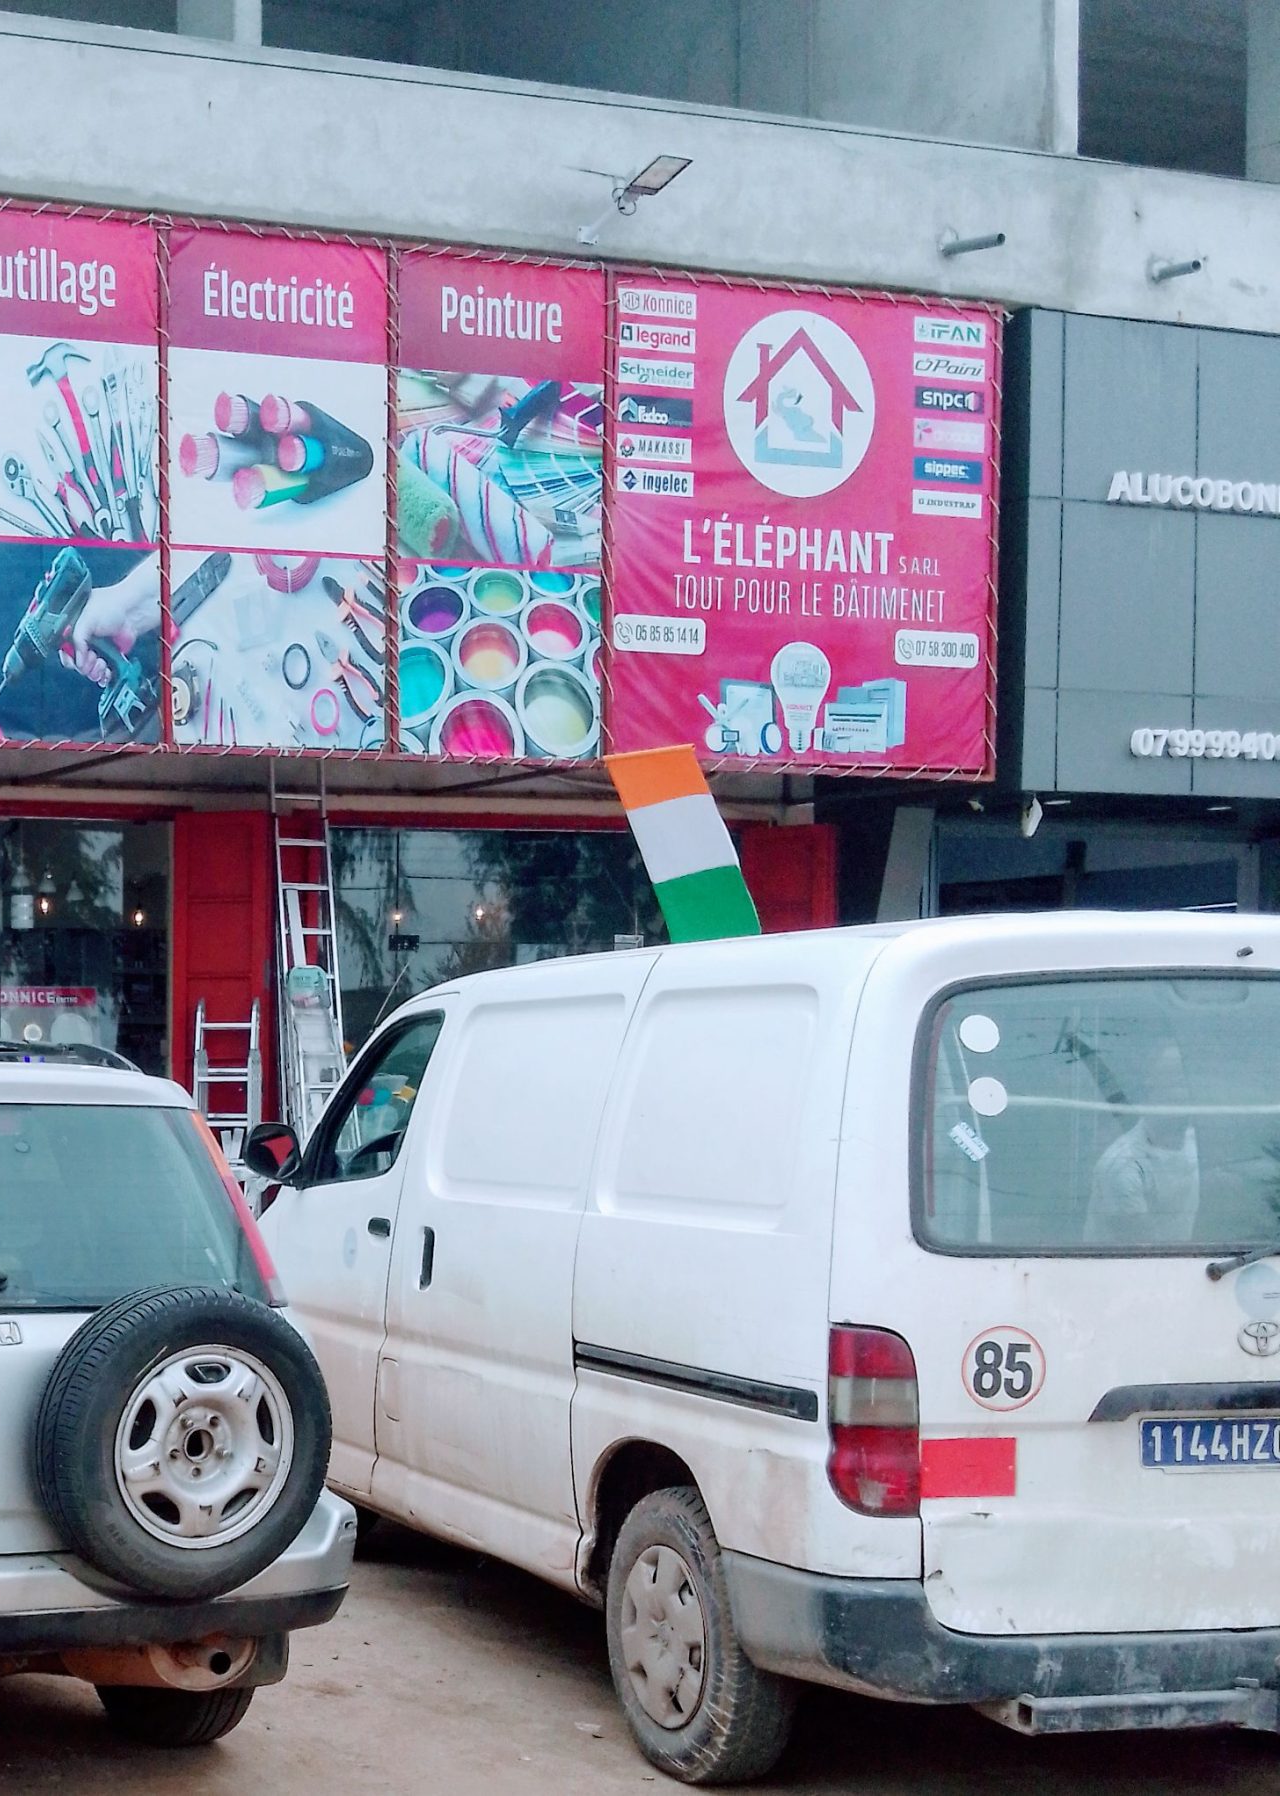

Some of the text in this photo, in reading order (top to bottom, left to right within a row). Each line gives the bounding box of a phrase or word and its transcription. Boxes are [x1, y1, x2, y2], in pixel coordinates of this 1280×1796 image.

[203, 262, 355, 329] Électricité
[642, 293, 693, 316] Konnice
[440, 286, 563, 343] Peinture
[636, 325, 691, 349] legrand
[620, 362, 693, 379] Schneider
[638, 439, 686, 455] MAKASSI
[642, 472, 688, 493] ingelec
[1107, 470, 1280, 513] ALUCOBON
[682, 512, 895, 575] L'ÉLÉPHANT
[673, 574, 946, 623] TOUT POUR LE BÂTIMENET
[635, 624, 699, 645] 05 85 85 14 14
[915, 640, 975, 659] 07 58 300 400
[973, 1341, 1032, 1399] 85
